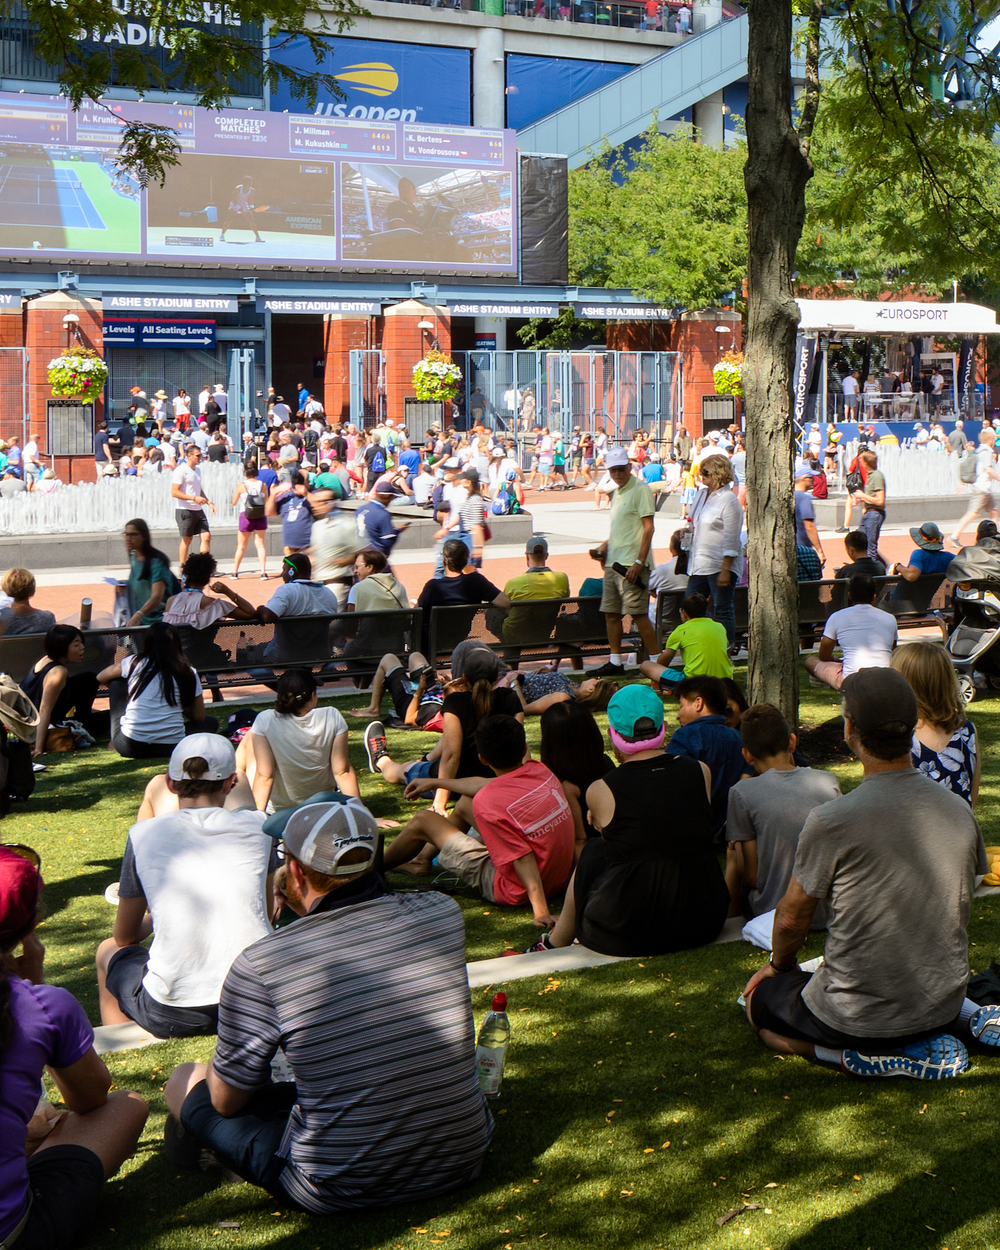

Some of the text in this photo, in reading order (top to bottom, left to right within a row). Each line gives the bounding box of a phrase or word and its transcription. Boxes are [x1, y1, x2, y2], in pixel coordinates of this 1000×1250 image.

[94, 103, 112, 112] Keys
[93, 115, 117, 124] Krunic
[214, 116, 266, 128] COMPLETED
[220, 125, 260, 134] MATCHES
[303, 127, 330, 136] Millman
[305, 139, 340, 148] Kukushkin
[417, 135, 442, 143] Bertens
[418, 147, 459, 156] Vondrousova
[0, 295, 12, 303] RY
[110, 297, 230, 308] ASHE STADIUM ENTRY
[264, 300, 374, 312] ASHE STADIUM ENTRY
[453, 304, 478, 313] ASHE
[481, 305, 521, 314] STADIUM
[581, 307, 605, 315] ASHE
[606, 308, 644, 316] STADIUM
[882, 308, 948, 320] EUROSPORT
[109, 325, 135, 334] Levels
[156, 326, 186, 335] Seating
[187, 326, 212, 335] Levels
[795, 346, 810, 415] EUROSPORT
[527, 810, 568, 840] vineyard
